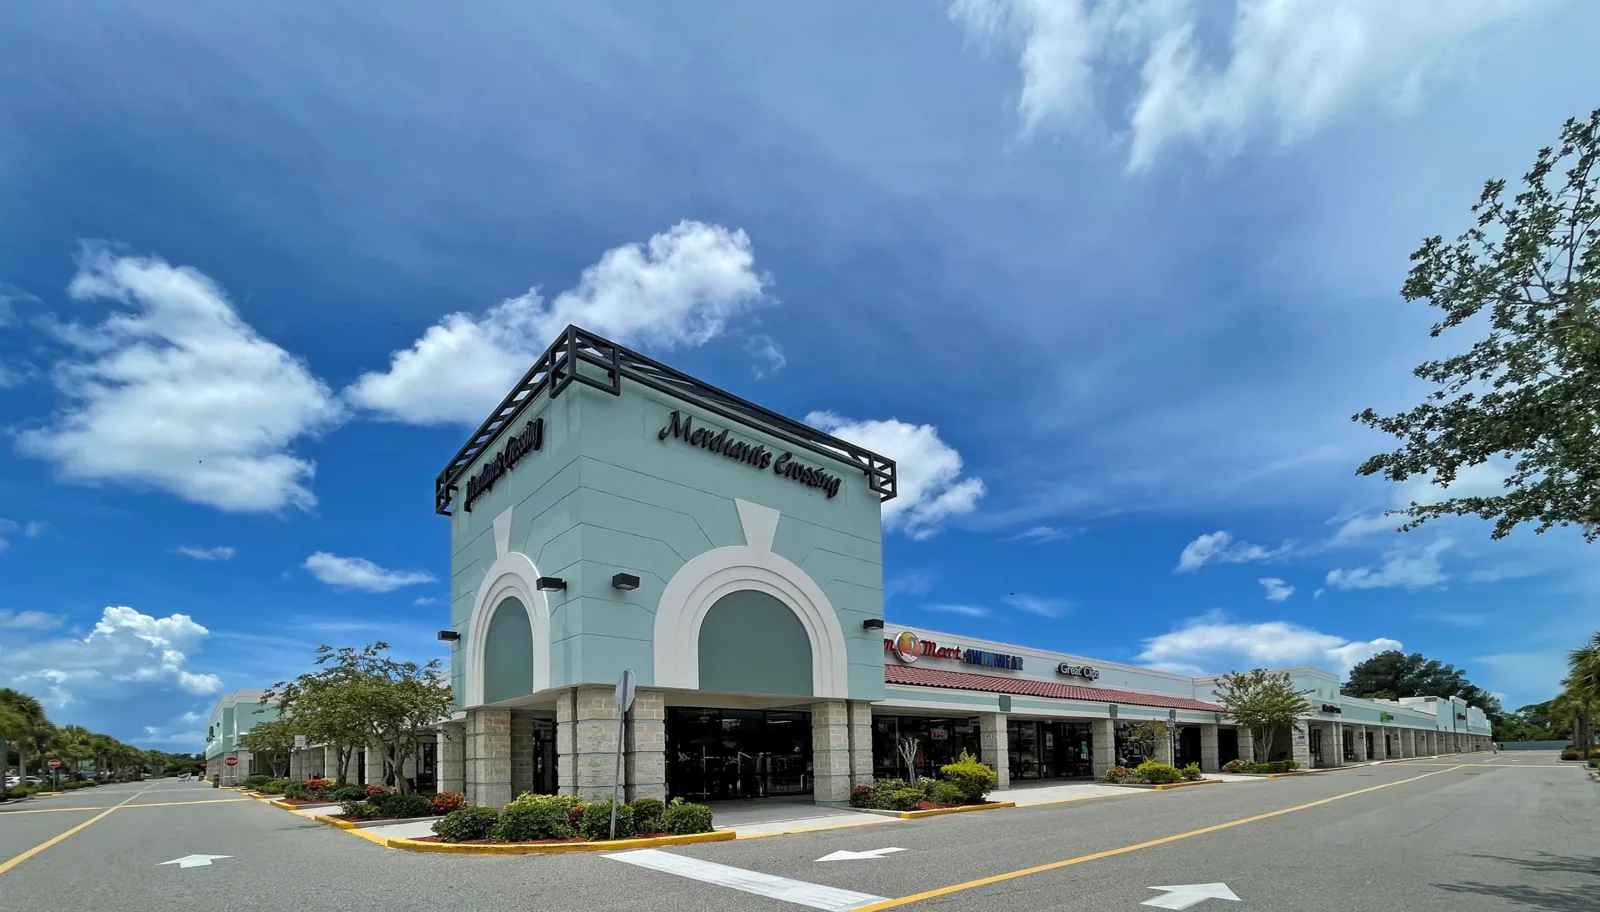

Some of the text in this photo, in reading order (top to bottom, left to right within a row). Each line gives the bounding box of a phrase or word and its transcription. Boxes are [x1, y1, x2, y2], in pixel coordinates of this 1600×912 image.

[658, 410, 842, 499] Merchants Crossing
[920, 639, 962, 661] Mart
[965, 648, 1024, 671] SWIMWEAR
[1057, 662, 1100, 681] Great Clips
